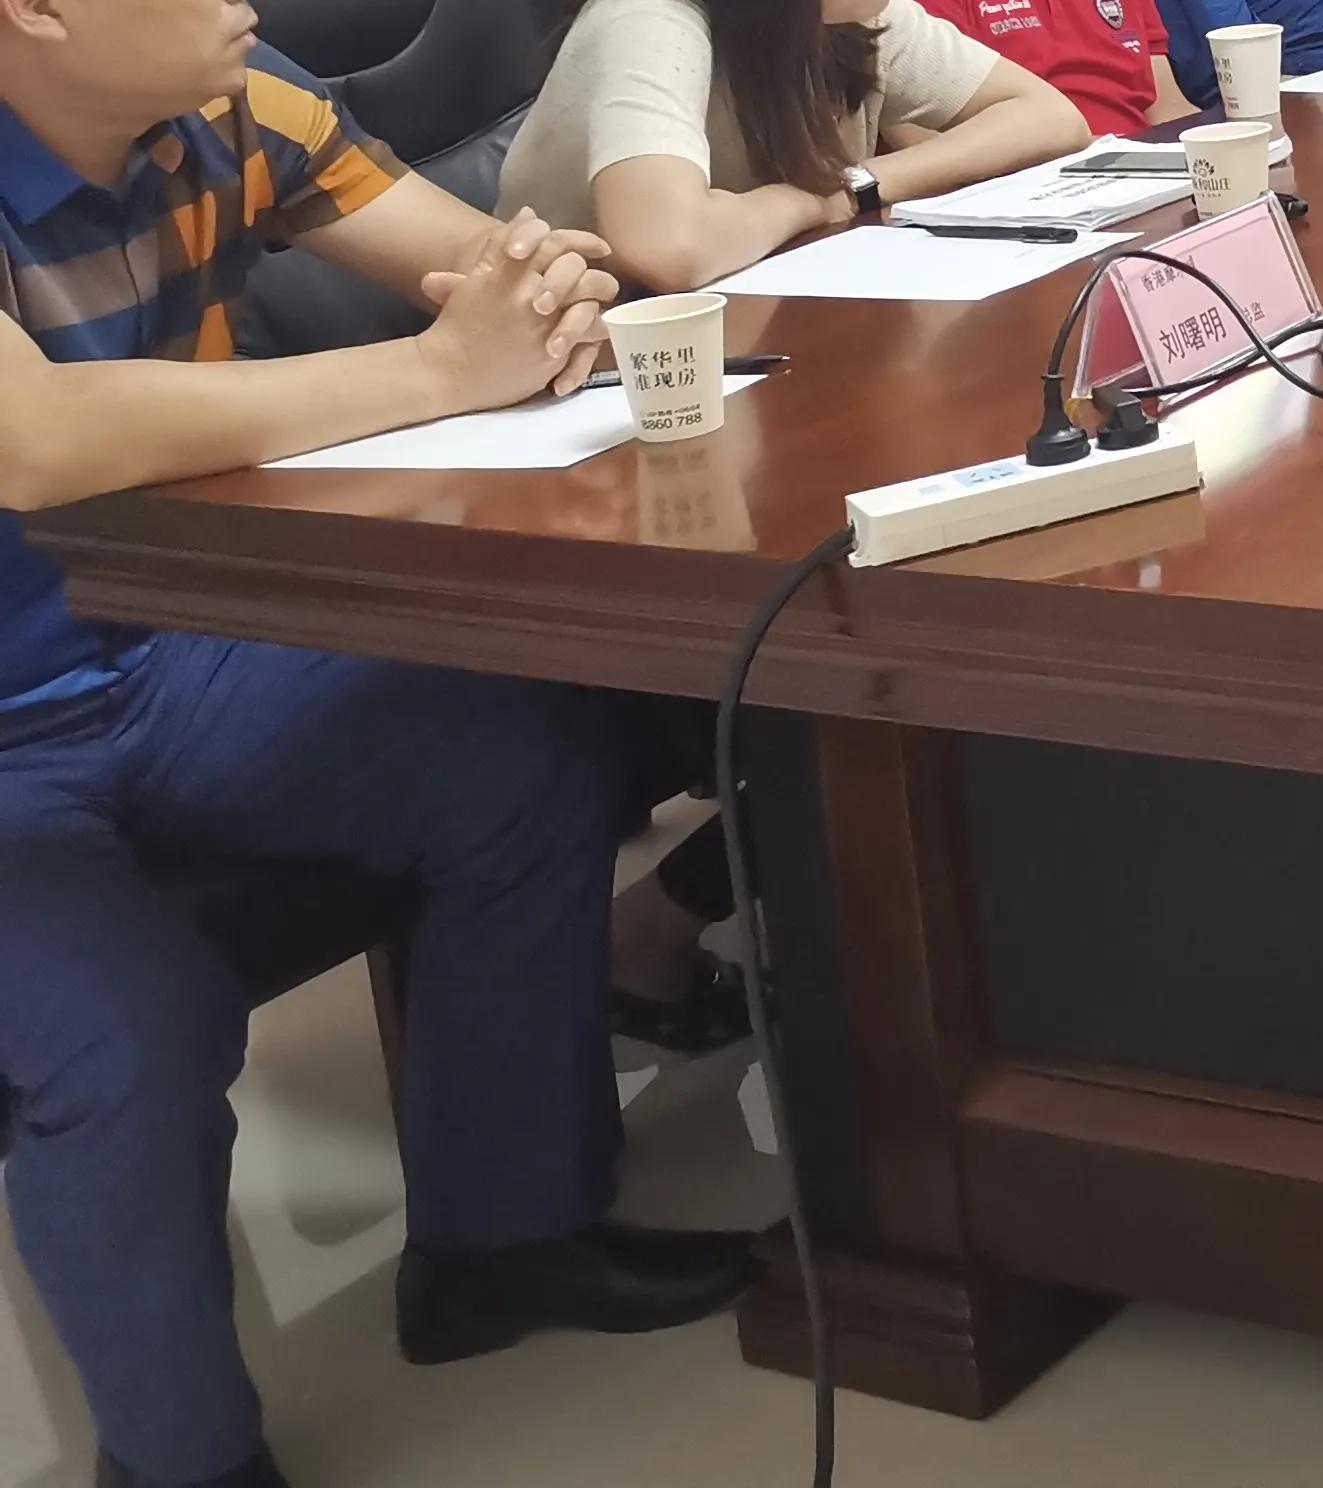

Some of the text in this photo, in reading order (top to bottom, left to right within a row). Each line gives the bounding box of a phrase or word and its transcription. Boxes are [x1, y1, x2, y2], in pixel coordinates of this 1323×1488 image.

[1159, 306, 1227, 365] 刘曙明
[677, 412, 703, 427] 788
